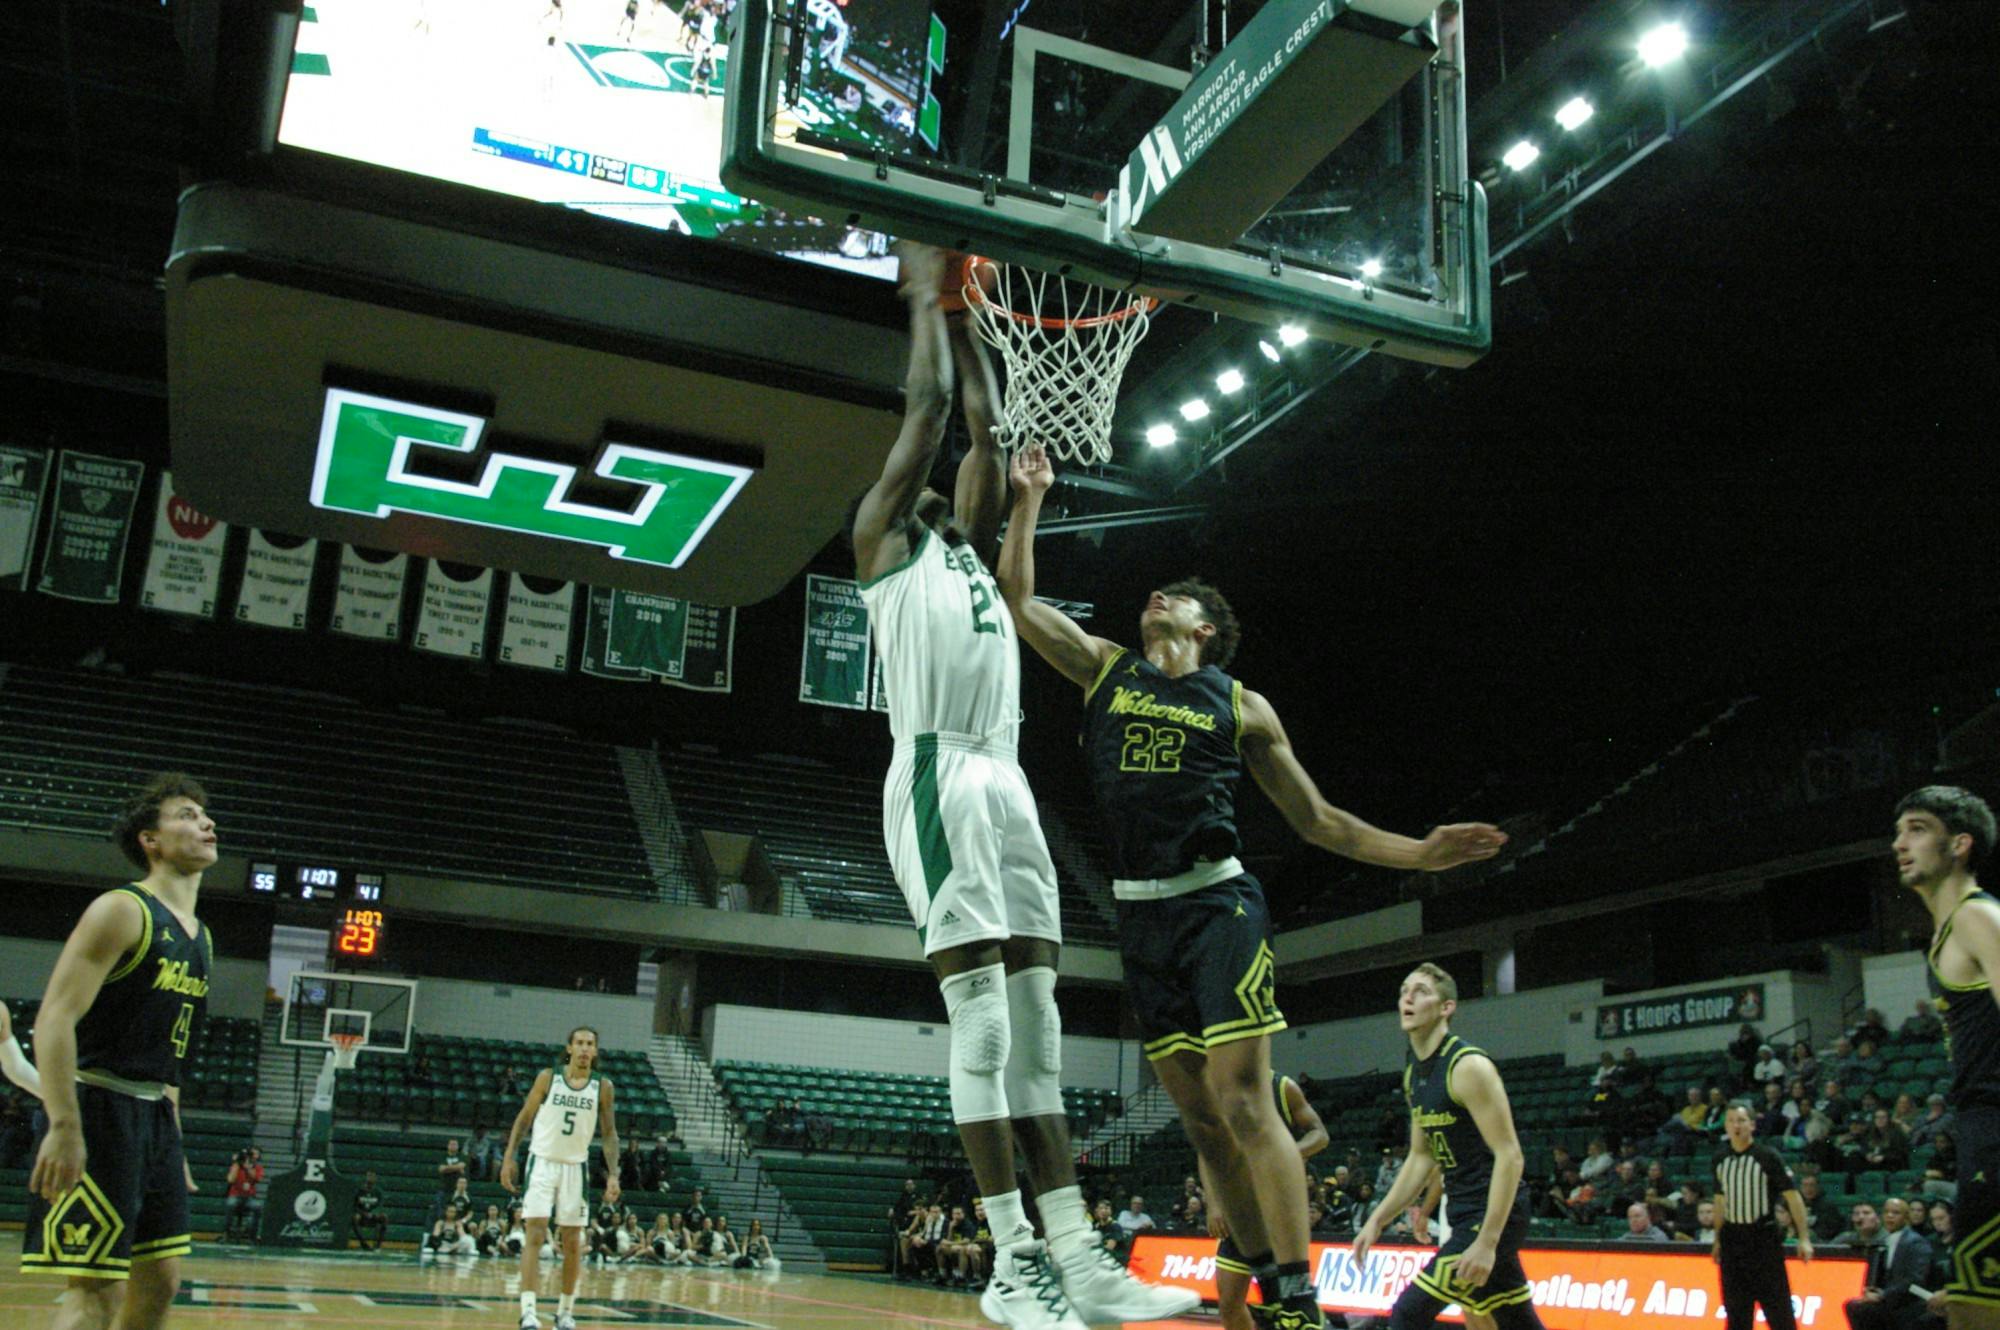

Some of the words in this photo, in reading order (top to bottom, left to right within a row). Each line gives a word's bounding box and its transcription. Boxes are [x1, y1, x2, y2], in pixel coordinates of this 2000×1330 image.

[1182, 60, 1236, 127] MARRIOTT
[1183, 95, 1241, 162] YPSILANTI
[1243, 48, 1283, 99] EAGLE
[1284, 1, 1328, 53] CREST
[1183, 112, 1206, 145] ANN
[1208, 69, 1246, 122] ARBOR
[310, 385, 756, 569] E
[624, 595, 676, 611] CHAMPIONS
[610, 651, 621, 664] E
[667, 660, 679, 674] E
[1107, 686, 1216, 731] Wolverines
[1120, 722, 1187, 773] 22
[255, 874, 274, 891] 55
[301, 868, 337, 885] 11:07
[359, 885, 379, 900] 41
[302, 886, 313, 899] 2
[345, 909, 383, 927] 11:07
[340, 924, 376, 953] 23
[1624, 1008, 1635, 1031] E
[552, 1094, 593, 1110] EAGLES
[562, 1111, 577, 1136] 5
[304, 1159, 326, 1181] E
[1643, 1280, 1707, 1317] Ann
